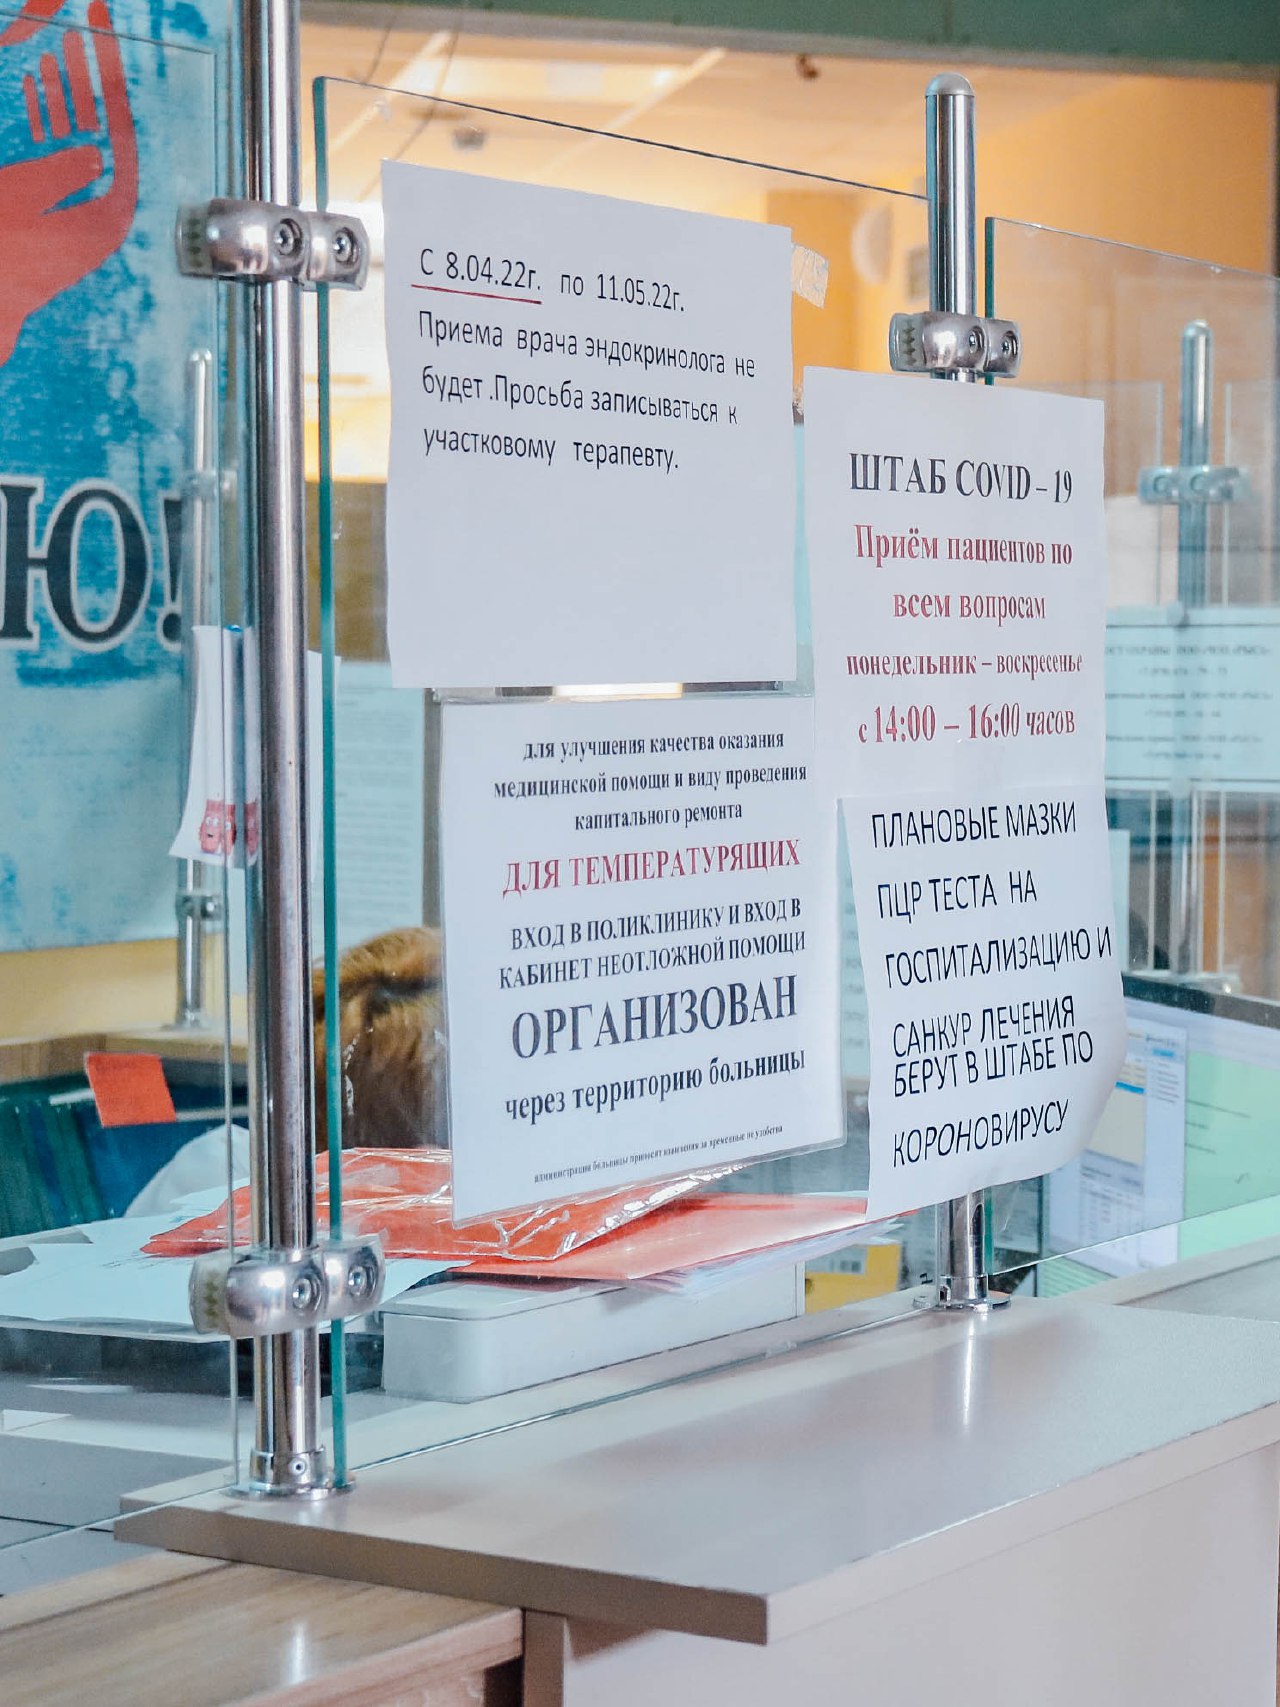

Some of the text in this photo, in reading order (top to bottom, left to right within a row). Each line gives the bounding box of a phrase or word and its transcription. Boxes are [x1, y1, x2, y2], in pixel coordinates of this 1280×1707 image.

[420, 248, 685, 312] С 8.04.22г. по 11.05.22г.
[419, 311, 755, 378] Приема врача эндокринолога не
[422, 365, 483, 402] будет
[591, 388, 718, 422] записываться
[729, 405, 738, 424] к
[424, 427, 679, 475] участковому терапевту.
[850, 453, 946, 494] ШТАБ
[956, 460, 1030, 500] COVID
[1054, 469, 1072, 503] 19
[855, 524, 1072, 568] Приём пациентов по
[893, 594, 1045, 627] всем вопросам
[847, 655, 976, 678] понедельник
[997, 654, 1083, 680] воскресенье
[523, 733, 784, 763] для улучшения качества оказания
[858, 723, 867, 743] с
[875, 705, 936, 743] 14:00
[969, 703, 1020, 739] 16:00
[1025, 709, 1075, 736] часов
[494, 766, 807, 799] медицинской помощи и виду проведения
[575, 803, 743, 831] капитального ремонта
[872, 801, 1077, 848] ПЛАНОВЫЕ МАЗКИ
[502, 839, 801, 898] ДЛЯ ТЕМПЕРАТУРЯЩИХ
[511, 897, 801, 951] ВХОД В ПОЛИКЛИНИКУ И ВХОД В
[878, 869, 1037, 924] ПЦР ТЕСТА НА
[500, 931, 806, 990] КАБИНЕТ НЕОТЛОЖНОЙ ПОМОЩИ
[885, 926, 1112, 988] ГОСПИТАЛИЗАЦИЮ И
[512, 975, 797, 1059] ОРГАНИЗОВАН
[893, 995, 1075, 1058] САНКУР ЛЕЧЕНИЯ
[505, 1048, 805, 1126] через территорию больницы
[894, 1031, 1094, 1097] БЕРУТ В ШТАБЕ ПО
[893, 1099, 1069, 1168] КОРОНОВИРУСУ
